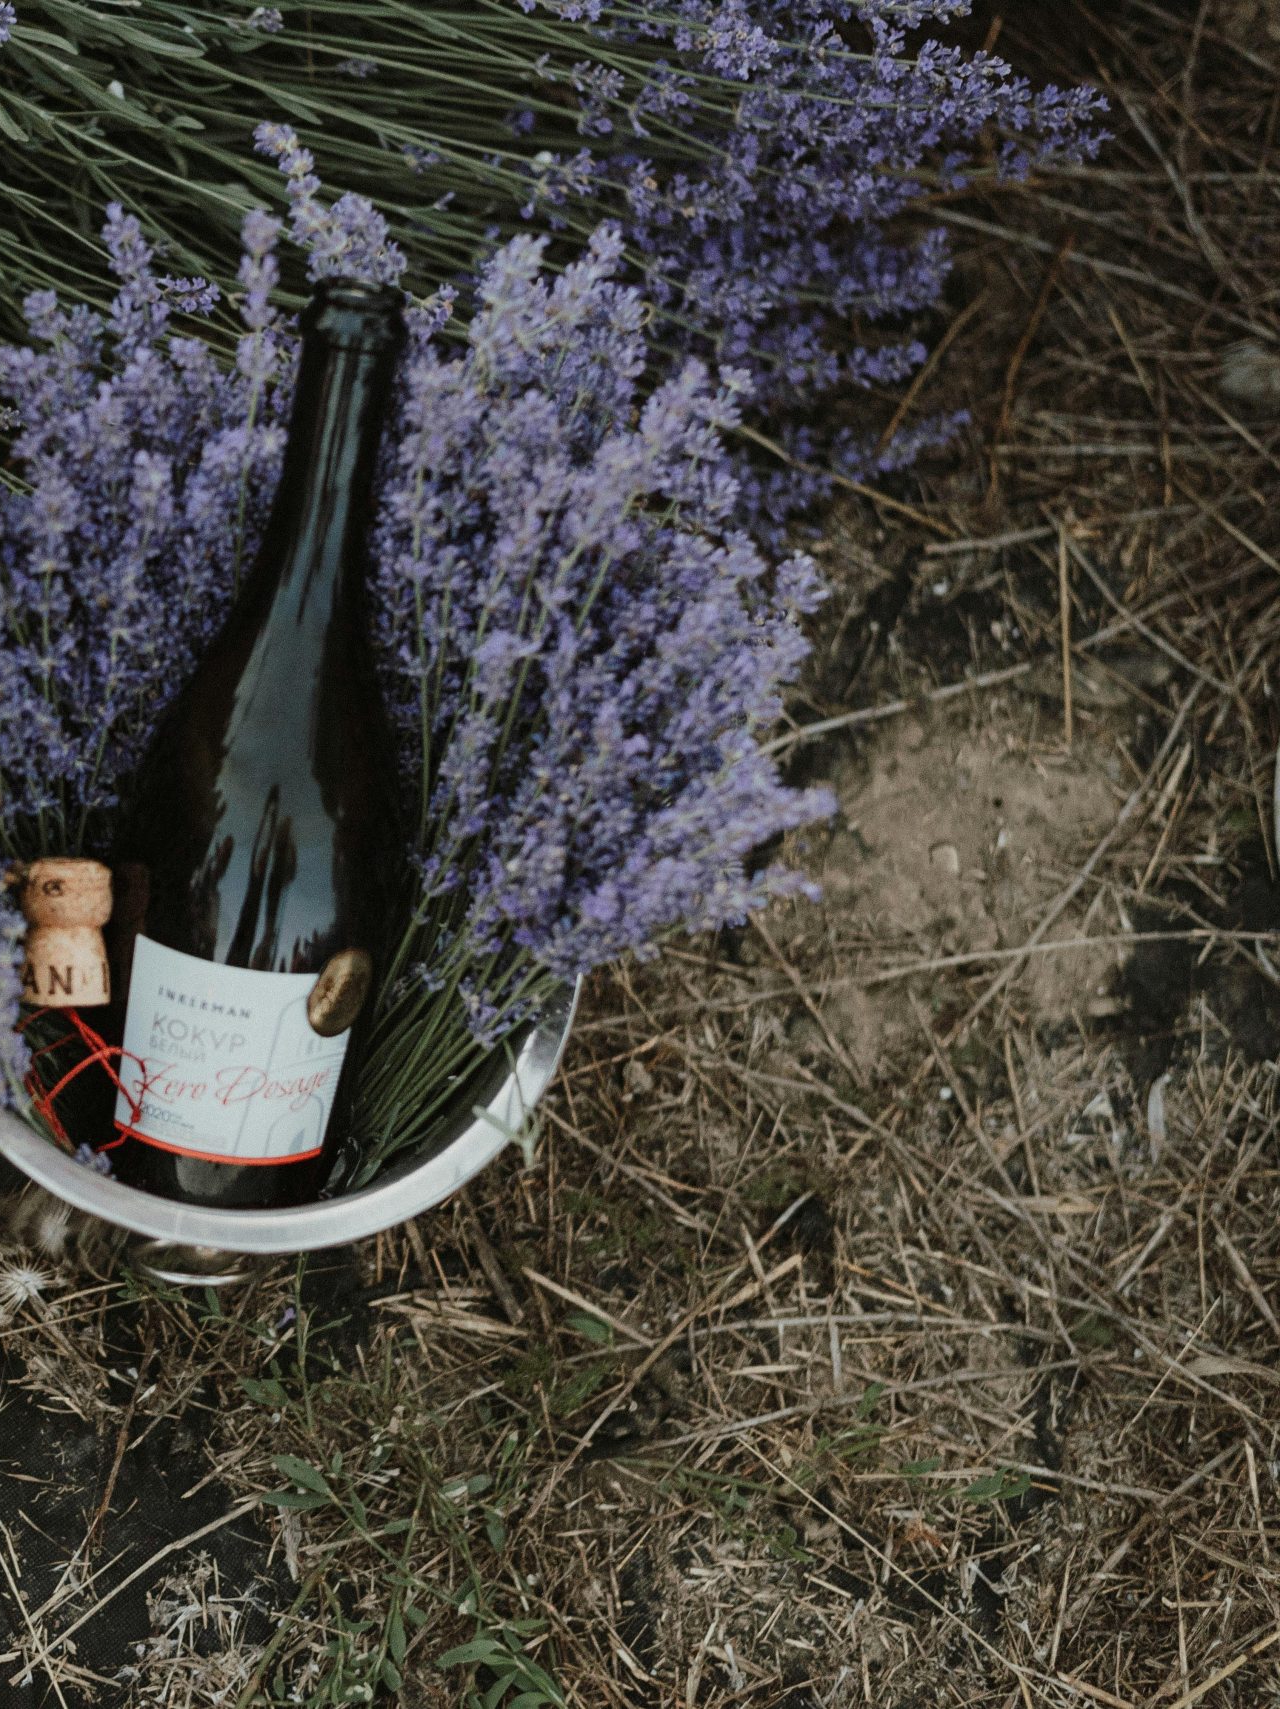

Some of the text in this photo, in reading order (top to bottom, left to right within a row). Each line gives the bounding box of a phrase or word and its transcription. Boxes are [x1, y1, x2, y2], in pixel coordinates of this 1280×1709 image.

[158, 984, 251, 1019] INKERMAN
[133, 1057, 331, 1112] Zero Dosage
